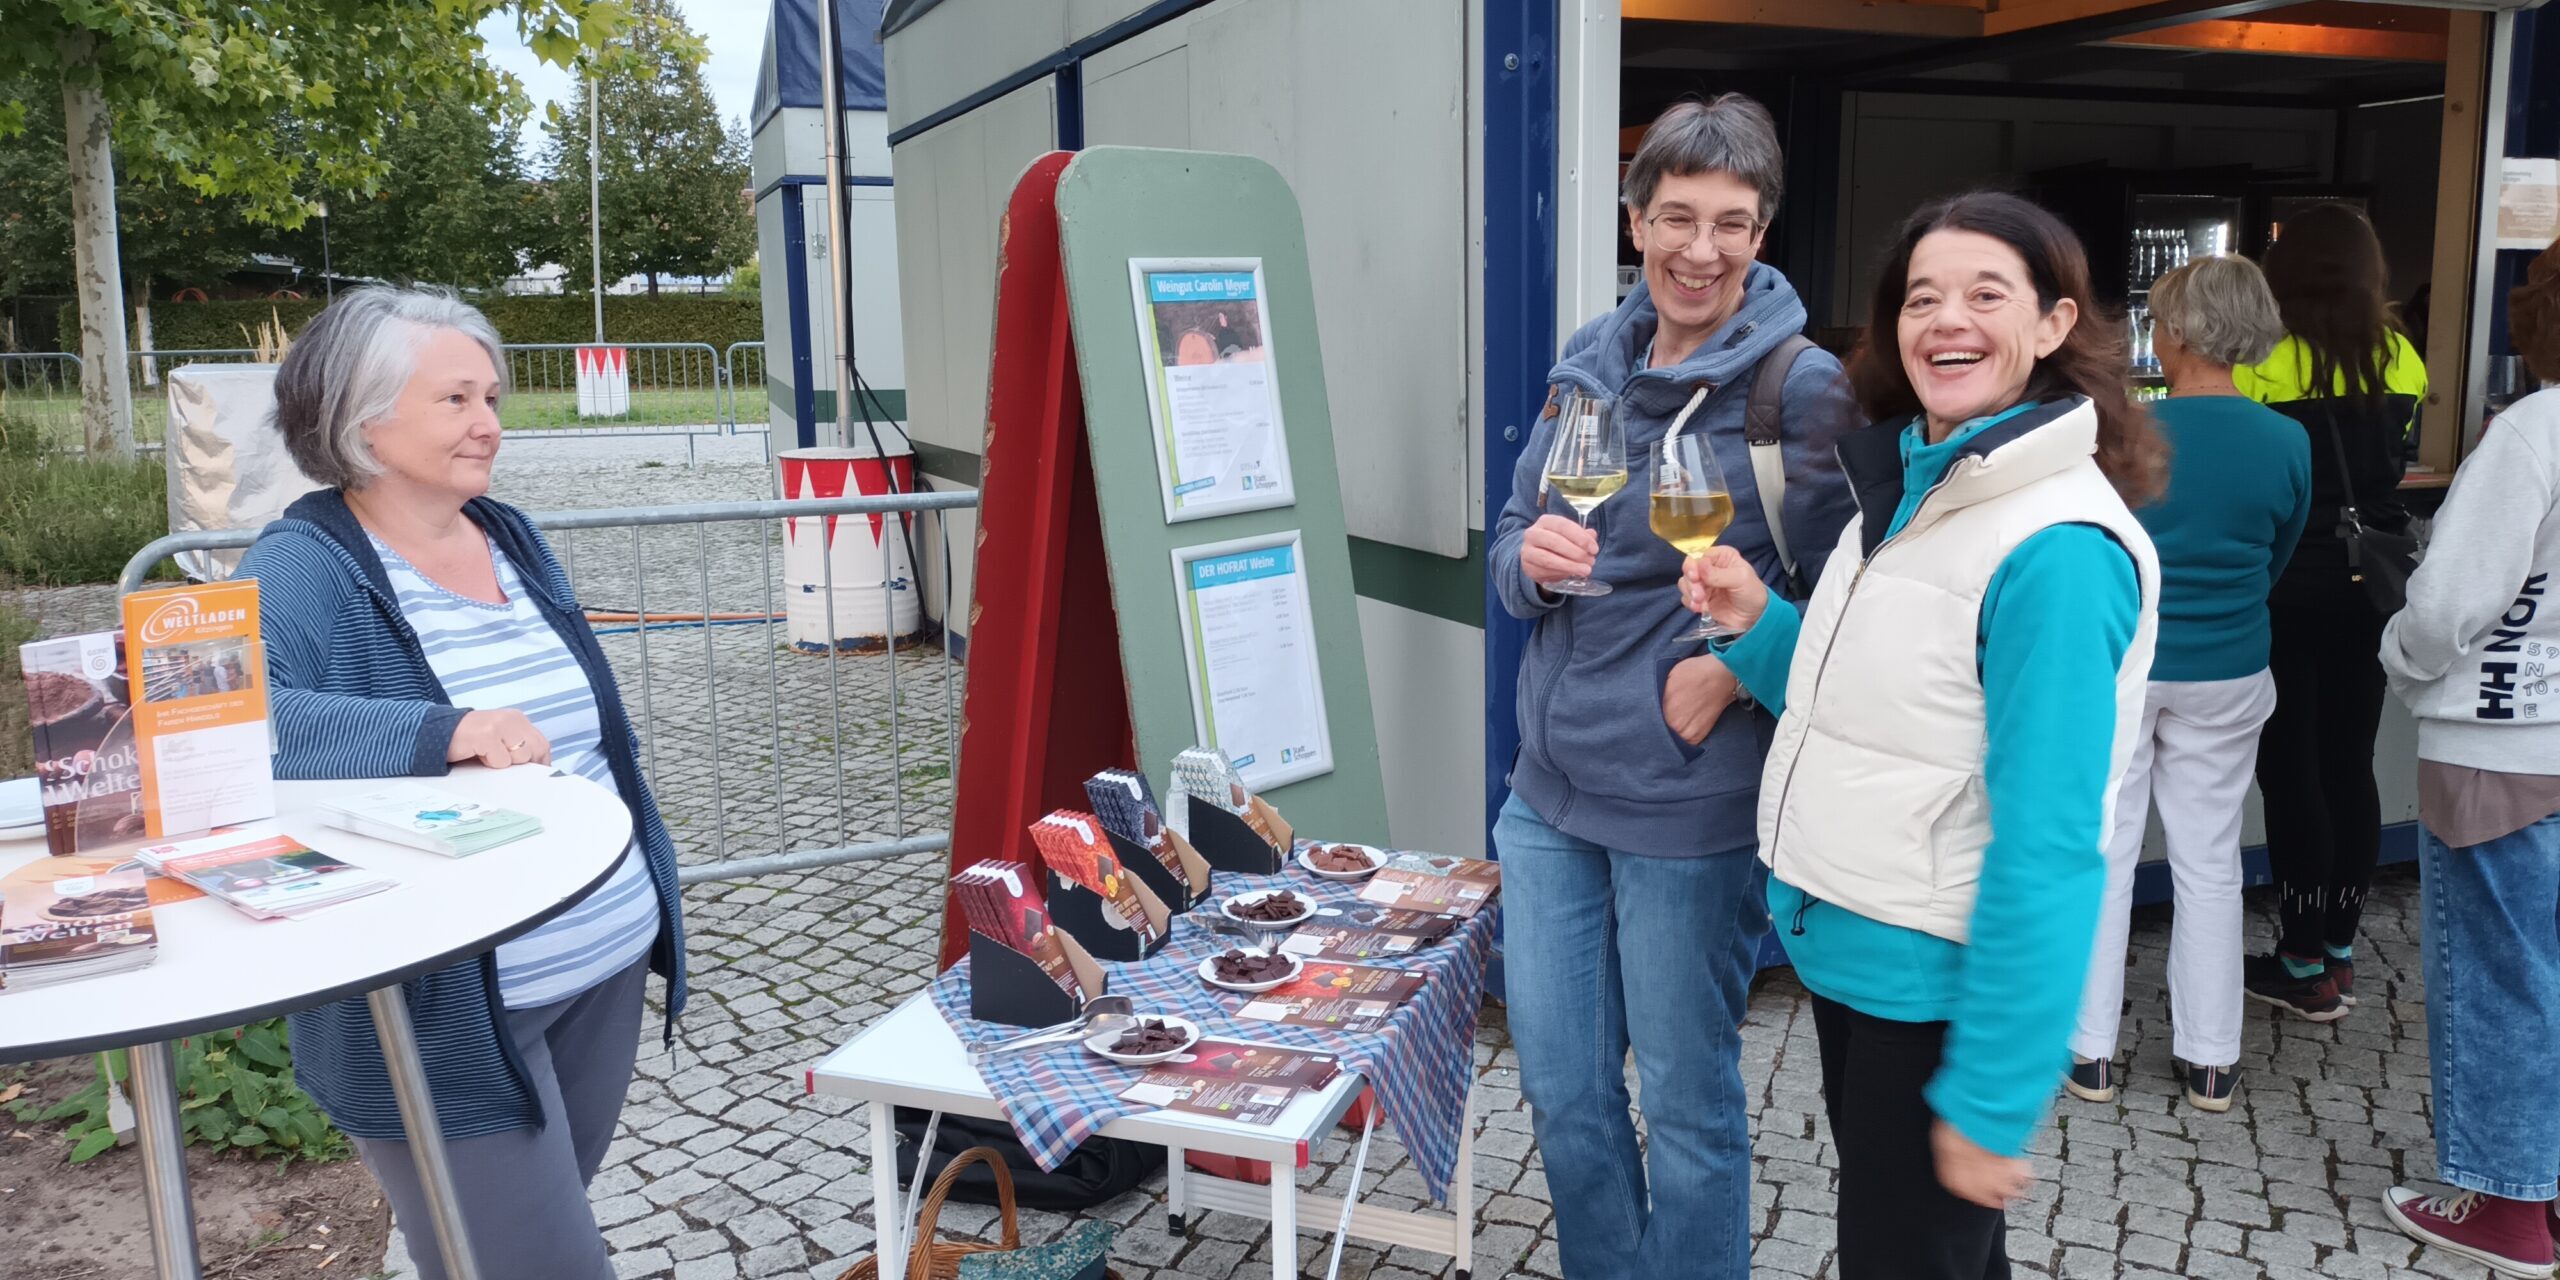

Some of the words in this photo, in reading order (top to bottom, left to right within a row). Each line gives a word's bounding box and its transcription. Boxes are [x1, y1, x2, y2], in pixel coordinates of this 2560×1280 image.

[1156, 279, 1194, 296] Weingut
[1194, 278, 1224, 293] Carolin
[1224, 278, 1250, 295] Meyer
[1199, 564, 1216, 578] DER
[1216, 559, 1248, 575] HOFRAT
[1249, 556, 1275, 570] Weine
[162, 608, 246, 630] WELTLADEN
[59, 745, 138, 780] Schok
[57, 773, 141, 803] Welte
[13, 912, 134, 934] Schoko
[13, 921, 134, 944] Welten
